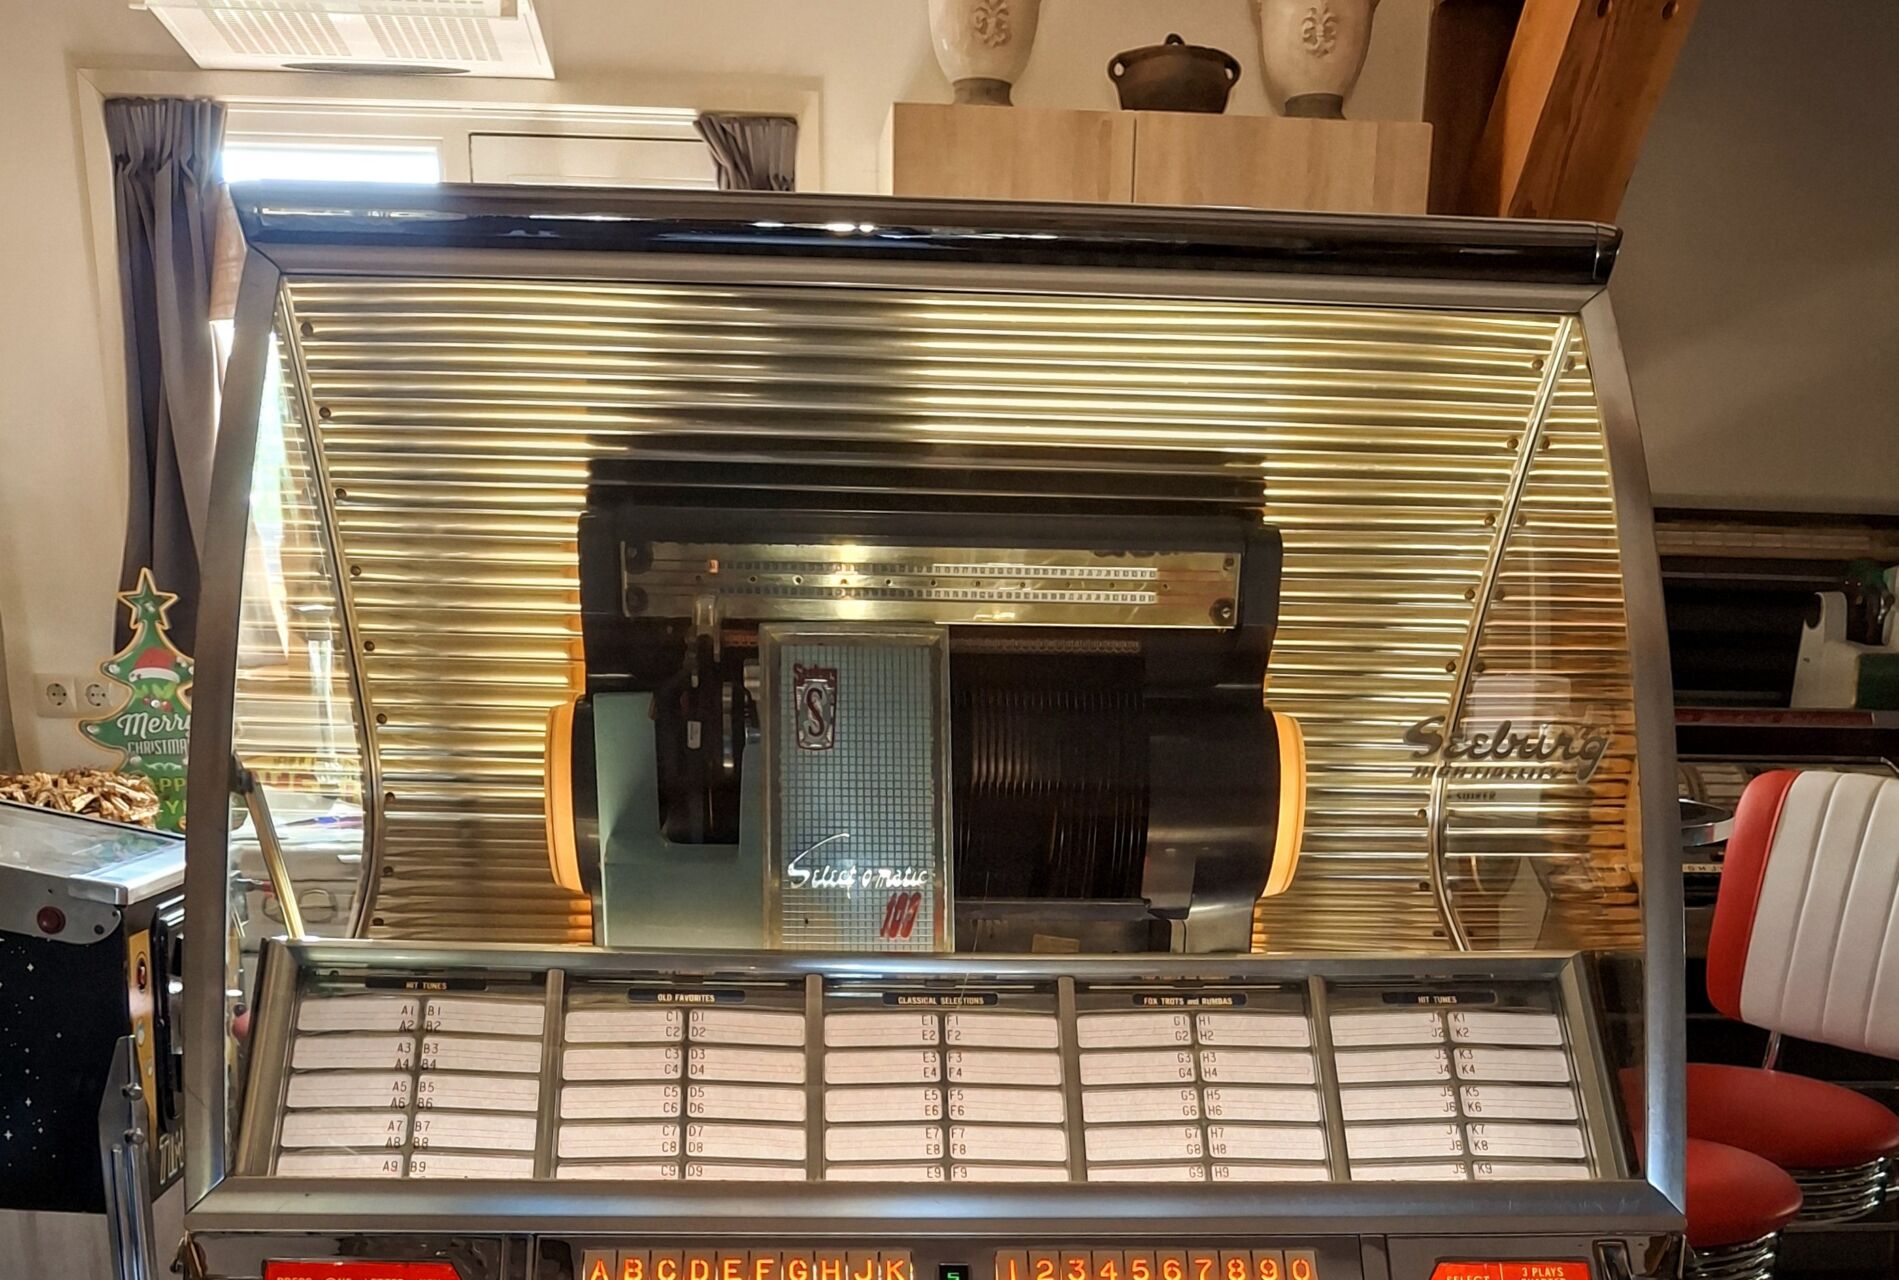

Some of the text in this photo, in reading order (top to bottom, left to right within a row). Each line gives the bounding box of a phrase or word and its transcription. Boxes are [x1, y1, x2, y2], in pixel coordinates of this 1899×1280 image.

[127, 738, 190, 755] CHRISTMA
[1403, 715, 1613, 785] Seeburg
[658, 994, 715, 1002] OLD FAVORITES
[898, 996, 984, 1005] CLASSICAL SELECTIONS
[1144, 997, 1158, 1005] FOX
[401, 1005, 414, 1015] A1
[428, 1006, 441, 1016] B1
[666, 1011, 678, 1022] C1
[692, 1011, 704, 1021] D1
[921, 1015, 933, 1025] E1
[947, 1015, 958, 1025] F1
[1173, 1016, 1185, 1026] G1
[1199, 1016, 1210, 1025] H1
[1453, 1013, 1465, 1023] K1
[399, 1020, 414, 1032] A2
[426, 1020, 441, 1032] B2
[666, 1026, 680, 1037] C2
[691, 1027, 706, 1037] D2
[922, 1030, 936, 1040] E2
[947, 1030, 961, 1041] F2
[1175, 1031, 1189, 1041] G2
[1200, 1031, 1214, 1041] H2
[1455, 1028, 1469, 1037] K2
[397, 1043, 411, 1053] A3
[423, 1043, 438, 1054] B3
[664, 1048, 679, 1059] C3
[690, 1049, 706, 1060] D3
[923, 1051, 936, 1063] E3
[948, 1052, 962, 1063] F3
[1177, 1052, 1191, 1063] G3
[1202, 1052, 1216, 1063] H3
[1459, 1049, 1473, 1060] K3
[394, 1058, 409, 1070] A4
[421, 1058, 436, 1070] B4
[664, 1063, 678, 1074] C4
[690, 1064, 704, 1075] D4
[1462, 1064, 1475, 1074] K4
[923, 1067, 936, 1078] E4
[949, 1067, 962, 1078] F4
[1178, 1067, 1192, 1078] G4
[1204, 1067, 1218, 1077] H4
[392, 1081, 407, 1092] A5
[419, 1081, 434, 1093] B5
[663, 1087, 678, 1097] C5
[1465, 1086, 1479, 1097] K5
[690, 1087, 704, 1098] D5
[924, 1089, 938, 1101] E5
[950, 1090, 964, 1101] F5
[1181, 1090, 1195, 1101] G5
[1206, 1090, 1221, 1100] H5
[391, 1097, 405, 1109] A6
[417, 1097, 433, 1109] B6
[663, 1102, 678, 1113] C6
[689, 1102, 704, 1113] D6
[1443, 1102, 1456, 1112] J6
[1467, 1102, 1482, 1112] K6
[925, 1105, 939, 1116] E6
[950, 1105, 964, 1116] F6
[1182, 1105, 1197, 1116] G6
[1208, 1105, 1222, 1116] H6
[387, 1120, 403, 1131] A7
[415, 1121, 430, 1132] B7
[662, 1125, 677, 1136] C7
[1471, 1124, 1485, 1135] K7
[689, 1126, 703, 1137] D7
[925, 1128, 939, 1139] E7
[951, 1128, 965, 1139] F7
[1184, 1128, 1199, 1139] G7
[1210, 1128, 1224, 1138] H7
[385, 1136, 401, 1148] A8
[661, 1141, 677, 1153] C8
[688, 1142, 703, 1153] D8
[1449, 1140, 1462, 1151] J8
[1474, 1140, 1489, 1151] K8
[926, 1144, 940, 1155] E8
[952, 1144, 966, 1155] F8
[1186, 1144, 1201, 1155] G8
[1212, 1144, 1226, 1155] H8
[382, 1160, 398, 1172] A9
[410, 1161, 426, 1172] B9
[661, 1165, 676, 1176] C9
[687, 1165, 703, 1177] D9
[1452, 1163, 1466, 1174] J9
[1477, 1163, 1493, 1174] K9
[927, 1167, 941, 1178] E9
[953, 1167, 967, 1178] F9
[1189, 1167, 1204, 1178] G9
[1214, 1166, 1229, 1178] H9
[1522, 1267, 1564, 1277] 3 PLAYS
